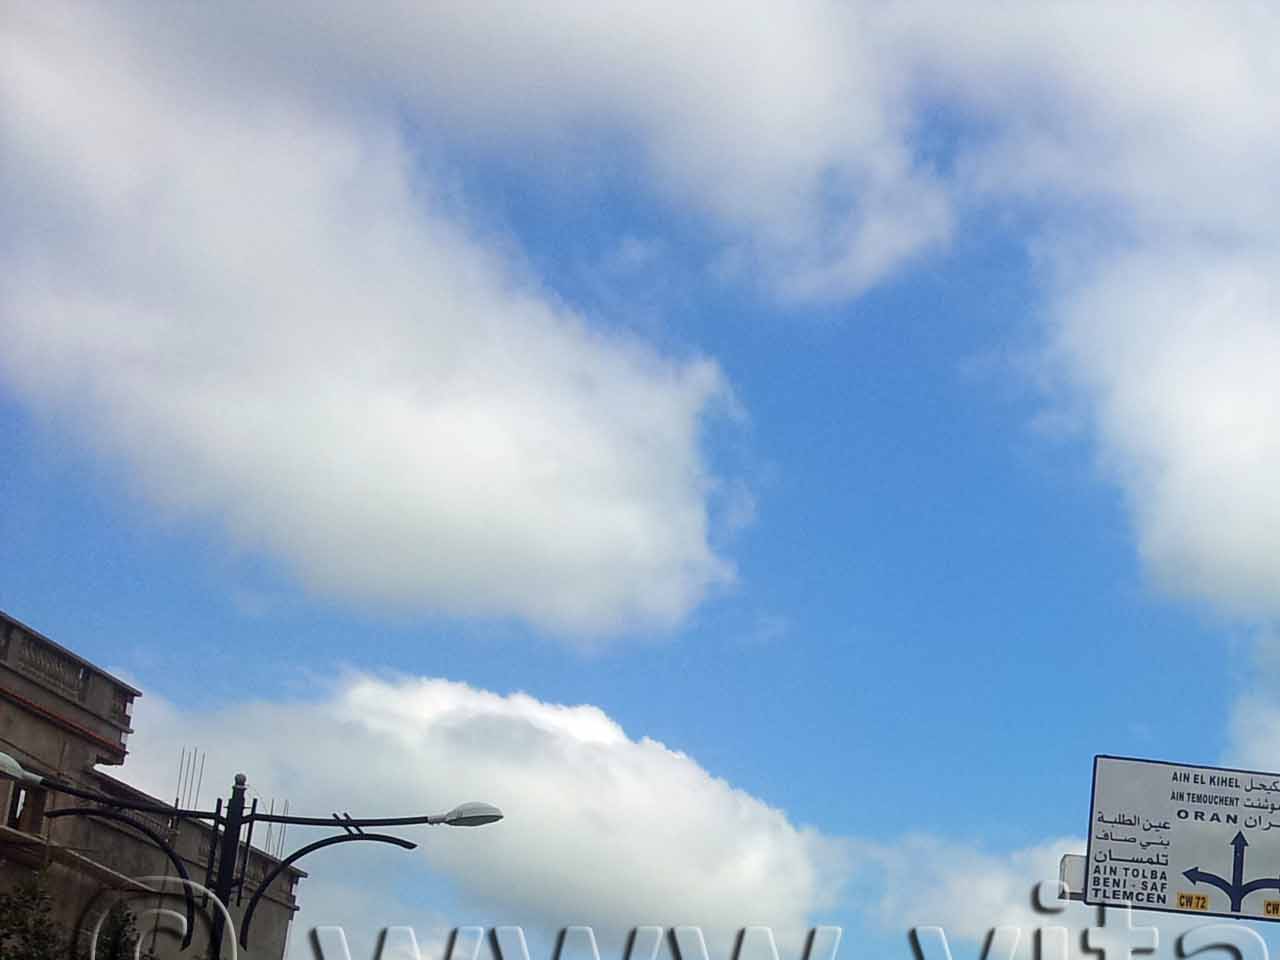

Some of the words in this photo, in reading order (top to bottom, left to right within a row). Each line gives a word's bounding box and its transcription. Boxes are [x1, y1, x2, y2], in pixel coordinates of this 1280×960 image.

[1171, 771, 1190, 783] AIN
[1193, 774, 1206, 784] EL
[1209, 775, 1241, 788] KIHEL
[1170, 791, 1185, 802] AIN
[1186, 793, 1240, 808] TEMOUCHENT
[1097, 811, 1140, 828] الطلبة
[1142, 818, 1171, 832] عين
[1176, 809, 1239, 825] ORAN
[1095, 829, 1137, 844] صاف
[1139, 836, 1170, 850] بني
[1094, 848, 1169, 866] تلمسان
[1093, 865, 1117, 877] AIN
[1122, 867, 1167, 881] TOLBA
[1092, 876, 1127, 889] BENI
[1141, 881, 1167, 893] SAF
[1092, 888, 1167, 905] TLEMCEN
[1178, 894, 1193, 907] CW
[1195, 896, 1207, 909] 72
[1265, 903, 1280, 915] CW
